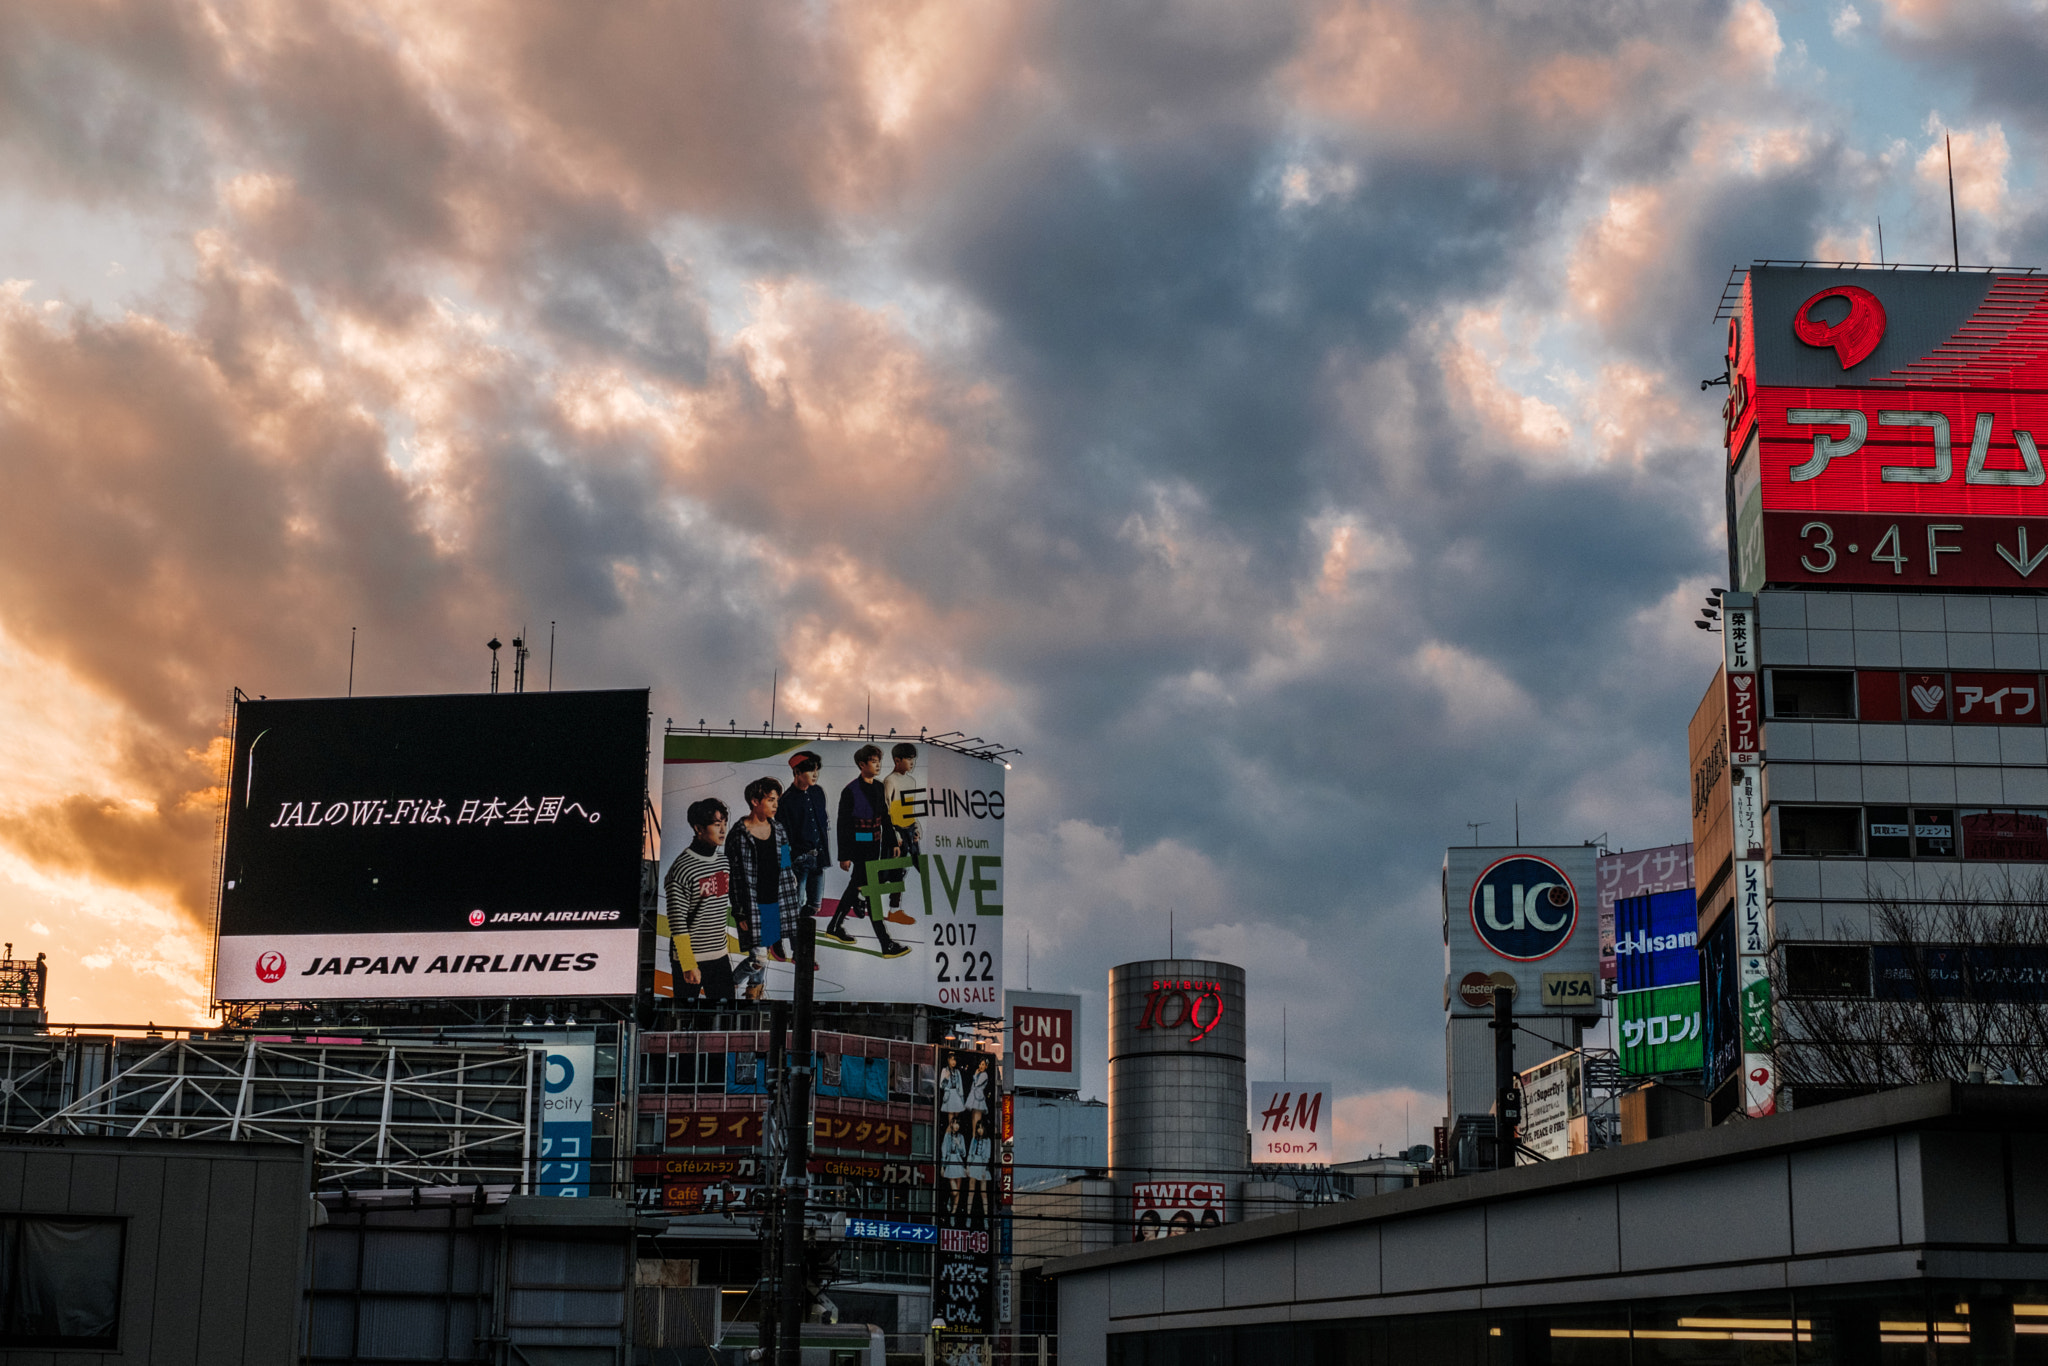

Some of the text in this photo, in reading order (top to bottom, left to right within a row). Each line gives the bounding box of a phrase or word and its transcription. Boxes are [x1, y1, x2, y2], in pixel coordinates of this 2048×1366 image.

[1787, 407, 2046, 486] アコム
[1955, 685, 2036, 715] アイフ
[1736, 691, 1753, 751] アイフル
[1738, 753, 1752, 763] 8F
[270, 795, 600, 828] JALのWi-Fiは、日本全国へ。
[935, 835, 989, 850] 5th Album
[860, 854, 1004, 922] FIVE
[490, 911, 541, 923] JAPAN
[544, 910, 620, 922] AIRLINES
[933, 923, 977, 947] 2017
[302, 952, 600, 976] JAPAN AIRLINES
[937, 951, 994, 983] 2.22
[938, 987, 996, 1004] ON SALE
[1152, 980, 1221, 991] SHIBUYA
[1548, 980, 1592, 996] VISA
[1020, 1015, 1061, 1038] UNI
[1135, 990, 1224, 1043] 109
[1019, 1041, 1066, 1066] QLO
[1261, 1092, 1322, 1133] H&M
[815, 1117, 908, 1146] コンタクト
[1267, 1142, 1304, 1154] 150m
[882, 1163, 926, 1185] ガスト
[668, 1187, 698, 1200] Café
[1135, 1184, 1223, 1207] TWICE
[853, 1220, 934, 1240] 英会話イーオン
[940, 1228, 989, 1254] HKT48
[949, 1283, 979, 1302] いい
[946, 1303, 982, 1324] じゃん
